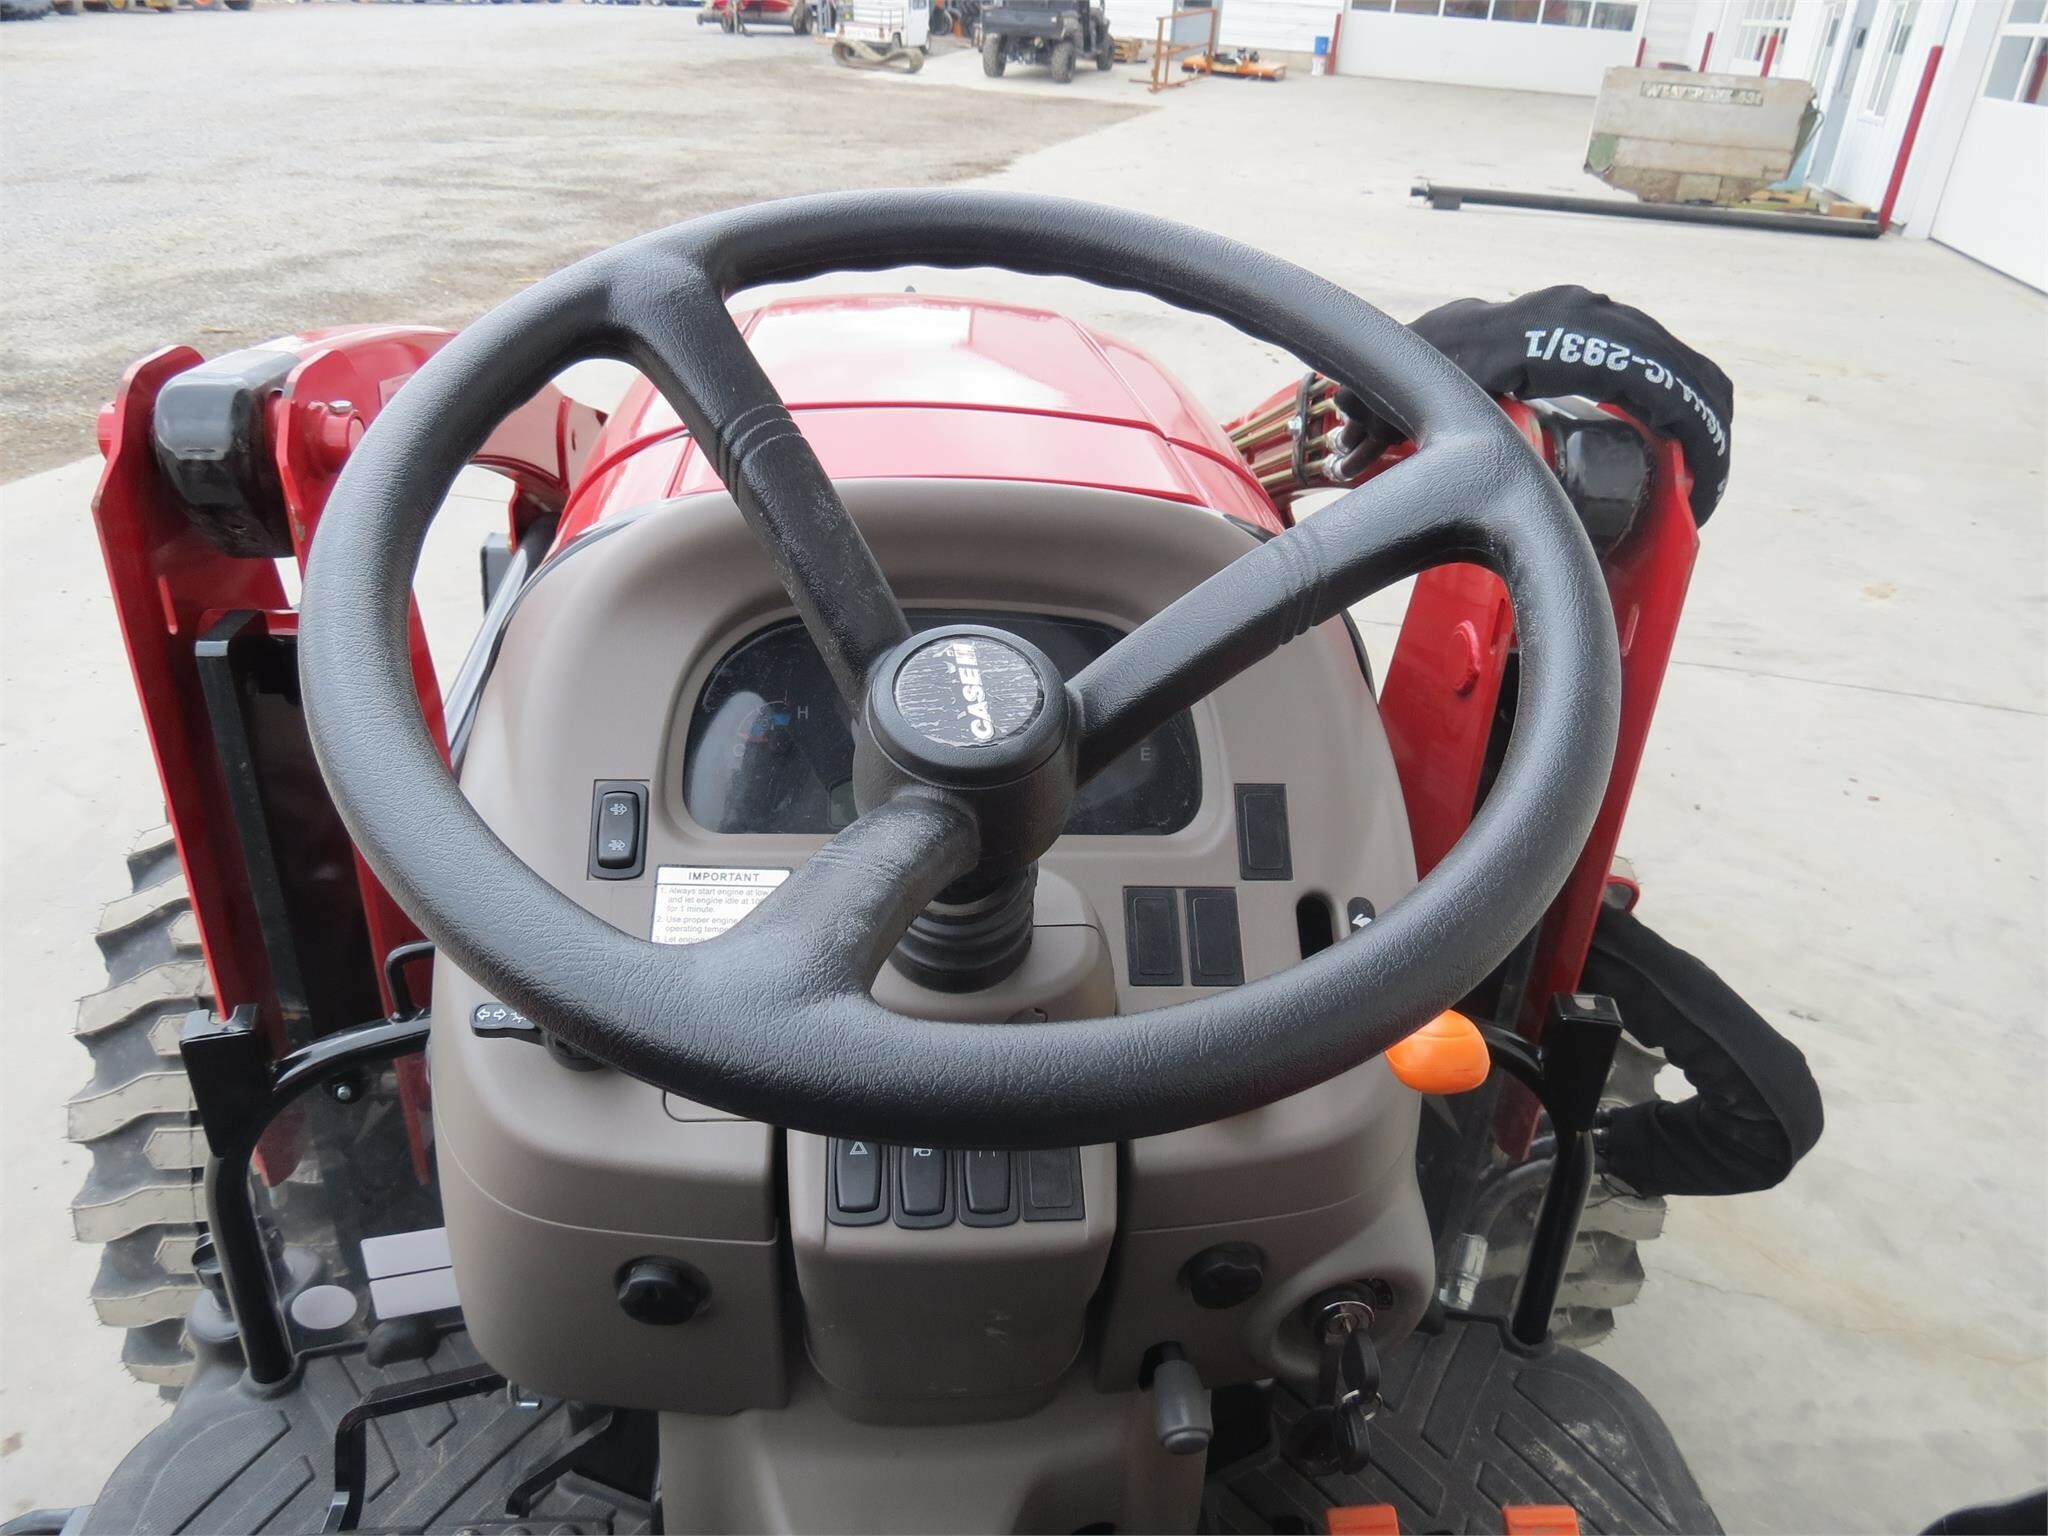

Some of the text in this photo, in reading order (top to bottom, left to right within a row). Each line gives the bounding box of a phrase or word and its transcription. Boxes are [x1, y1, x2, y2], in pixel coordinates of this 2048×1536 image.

[1525, 328, 1674, 390] IC-293/1
[958, 667, 995, 741] CASE
[797, 705, 809, 720] H
[1140, 747, 1152, 761] E
[688, 871, 761, 882] IMPORTANT
[668, 887, 697, 896] Always
[697, 888, 716, 896] start
[717, 888, 744, 897] engine
[755, 889, 769, 897] low
[696, 897, 724, 906] engine
[724, 897, 739, 905] idle
[665, 915, 682, 923] Use
[683, 917, 710, 926] proper
[711, 917, 738, 926] engine
[664, 925, 703, 934] operating
[664, 935, 678, 943] Let
